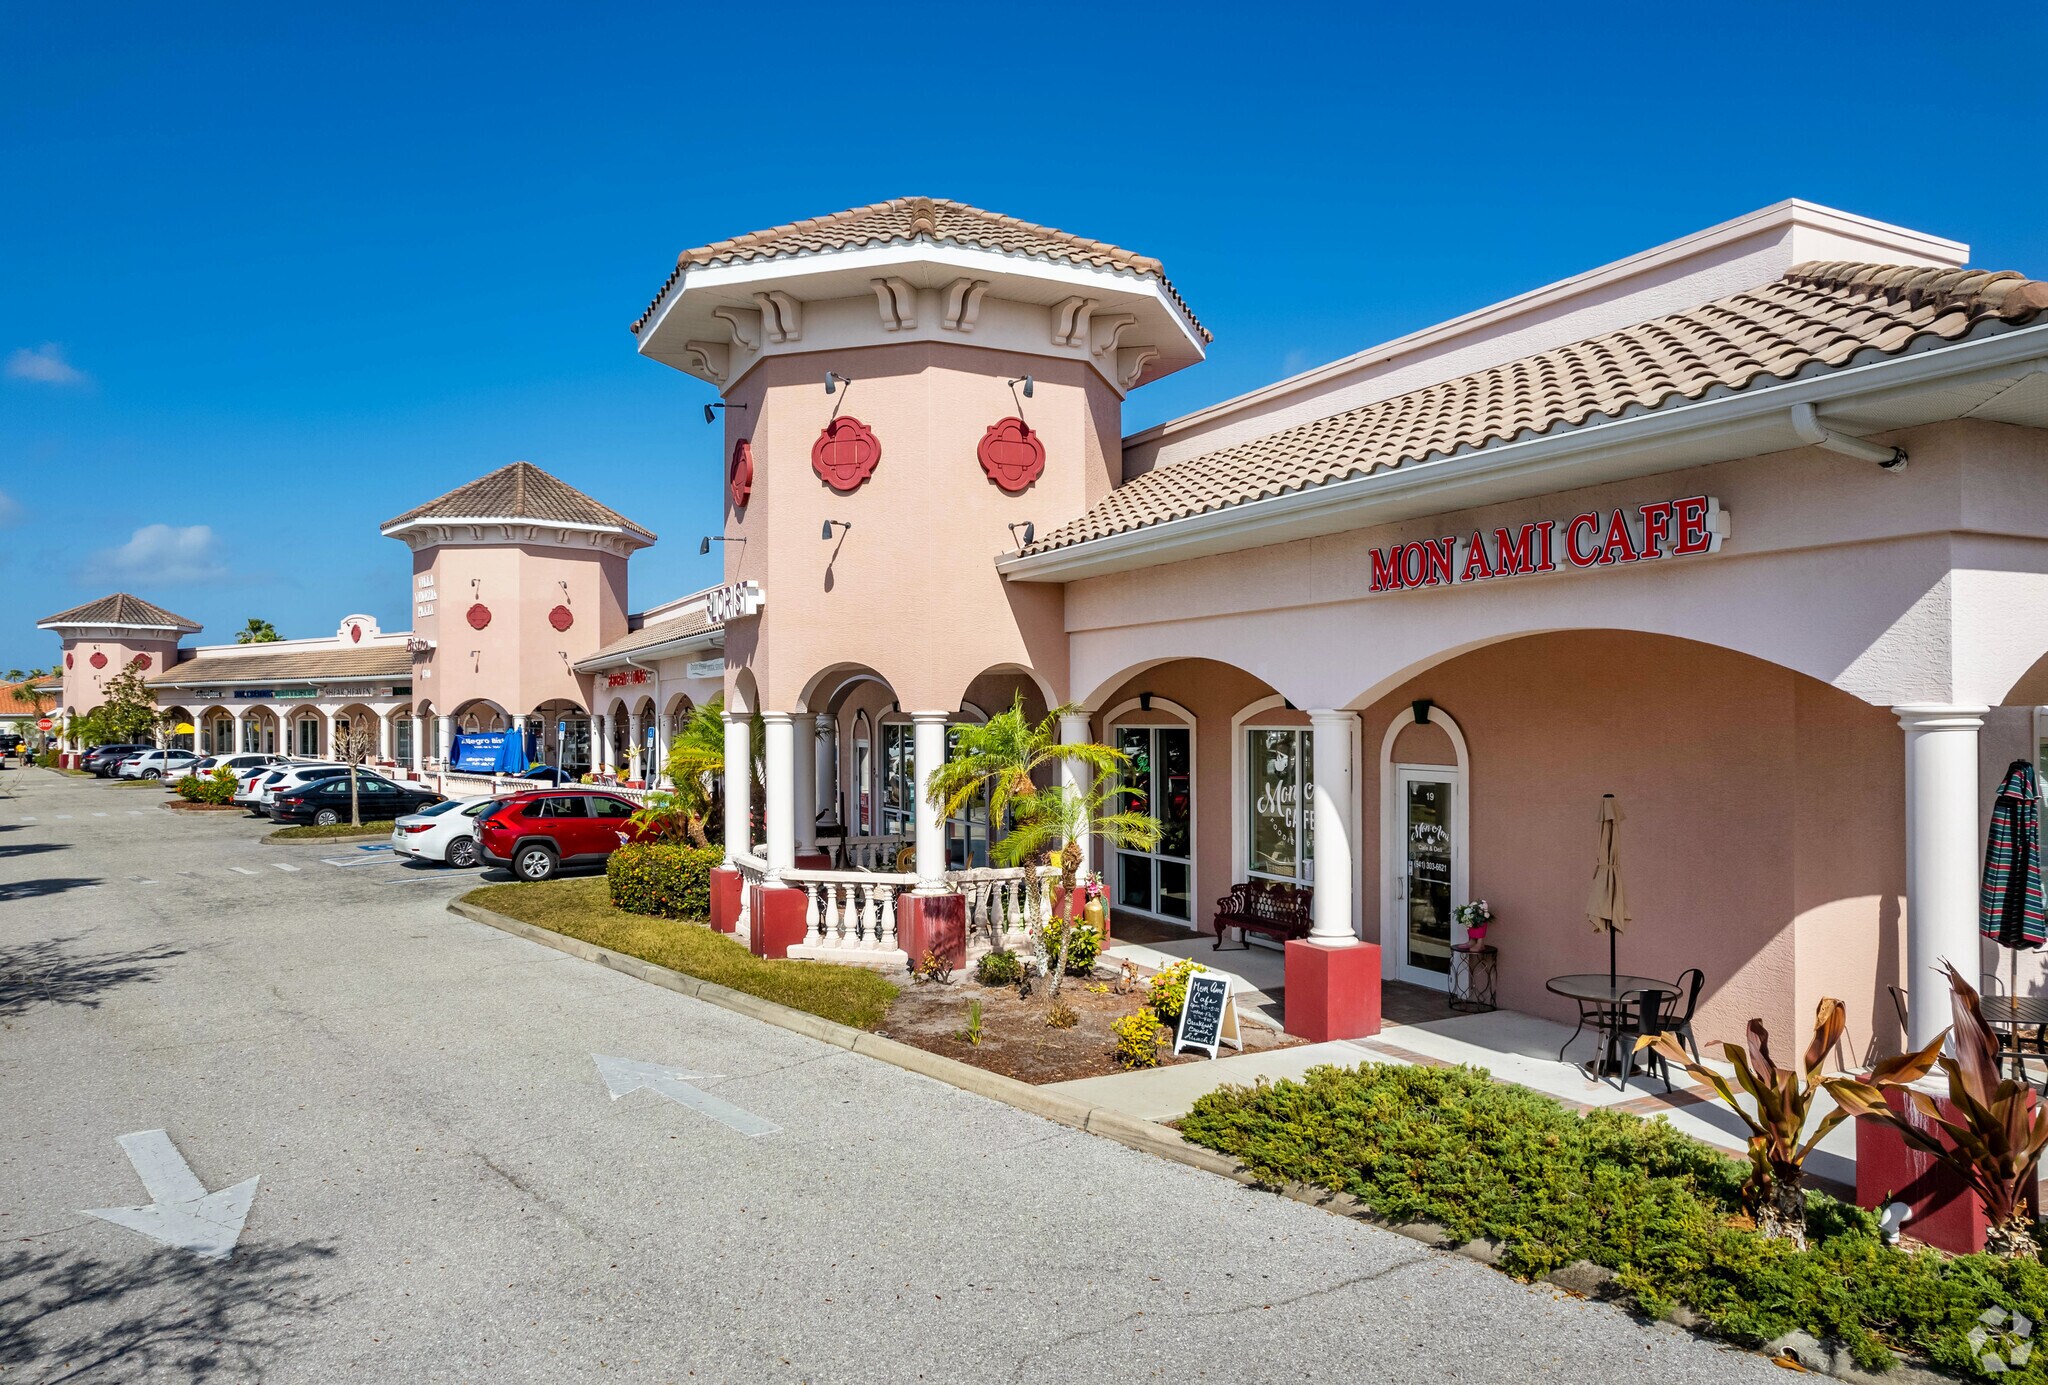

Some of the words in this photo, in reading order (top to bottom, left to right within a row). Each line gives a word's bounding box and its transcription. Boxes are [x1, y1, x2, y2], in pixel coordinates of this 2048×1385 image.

[1369, 536, 1457, 593] MON
[1460, 520, 1556, 582] AMI
[1564, 494, 1713, 568] CAFE
[706, 580, 752, 623] FLORIST
[407, 638, 429, 652] Bistro
[325, 687, 345, 698] SHEAR
[347, 687, 373, 698] HEAVEN
[461, 737, 490, 745] Allegro
[1257, 779, 1296, 817] Mon
[1426, 792, 1435, 801] 19
[1193, 981, 1209, 994] Mon
[1210, 981, 1224, 995] Ami
[1193, 992, 1217, 1005] Cafe
